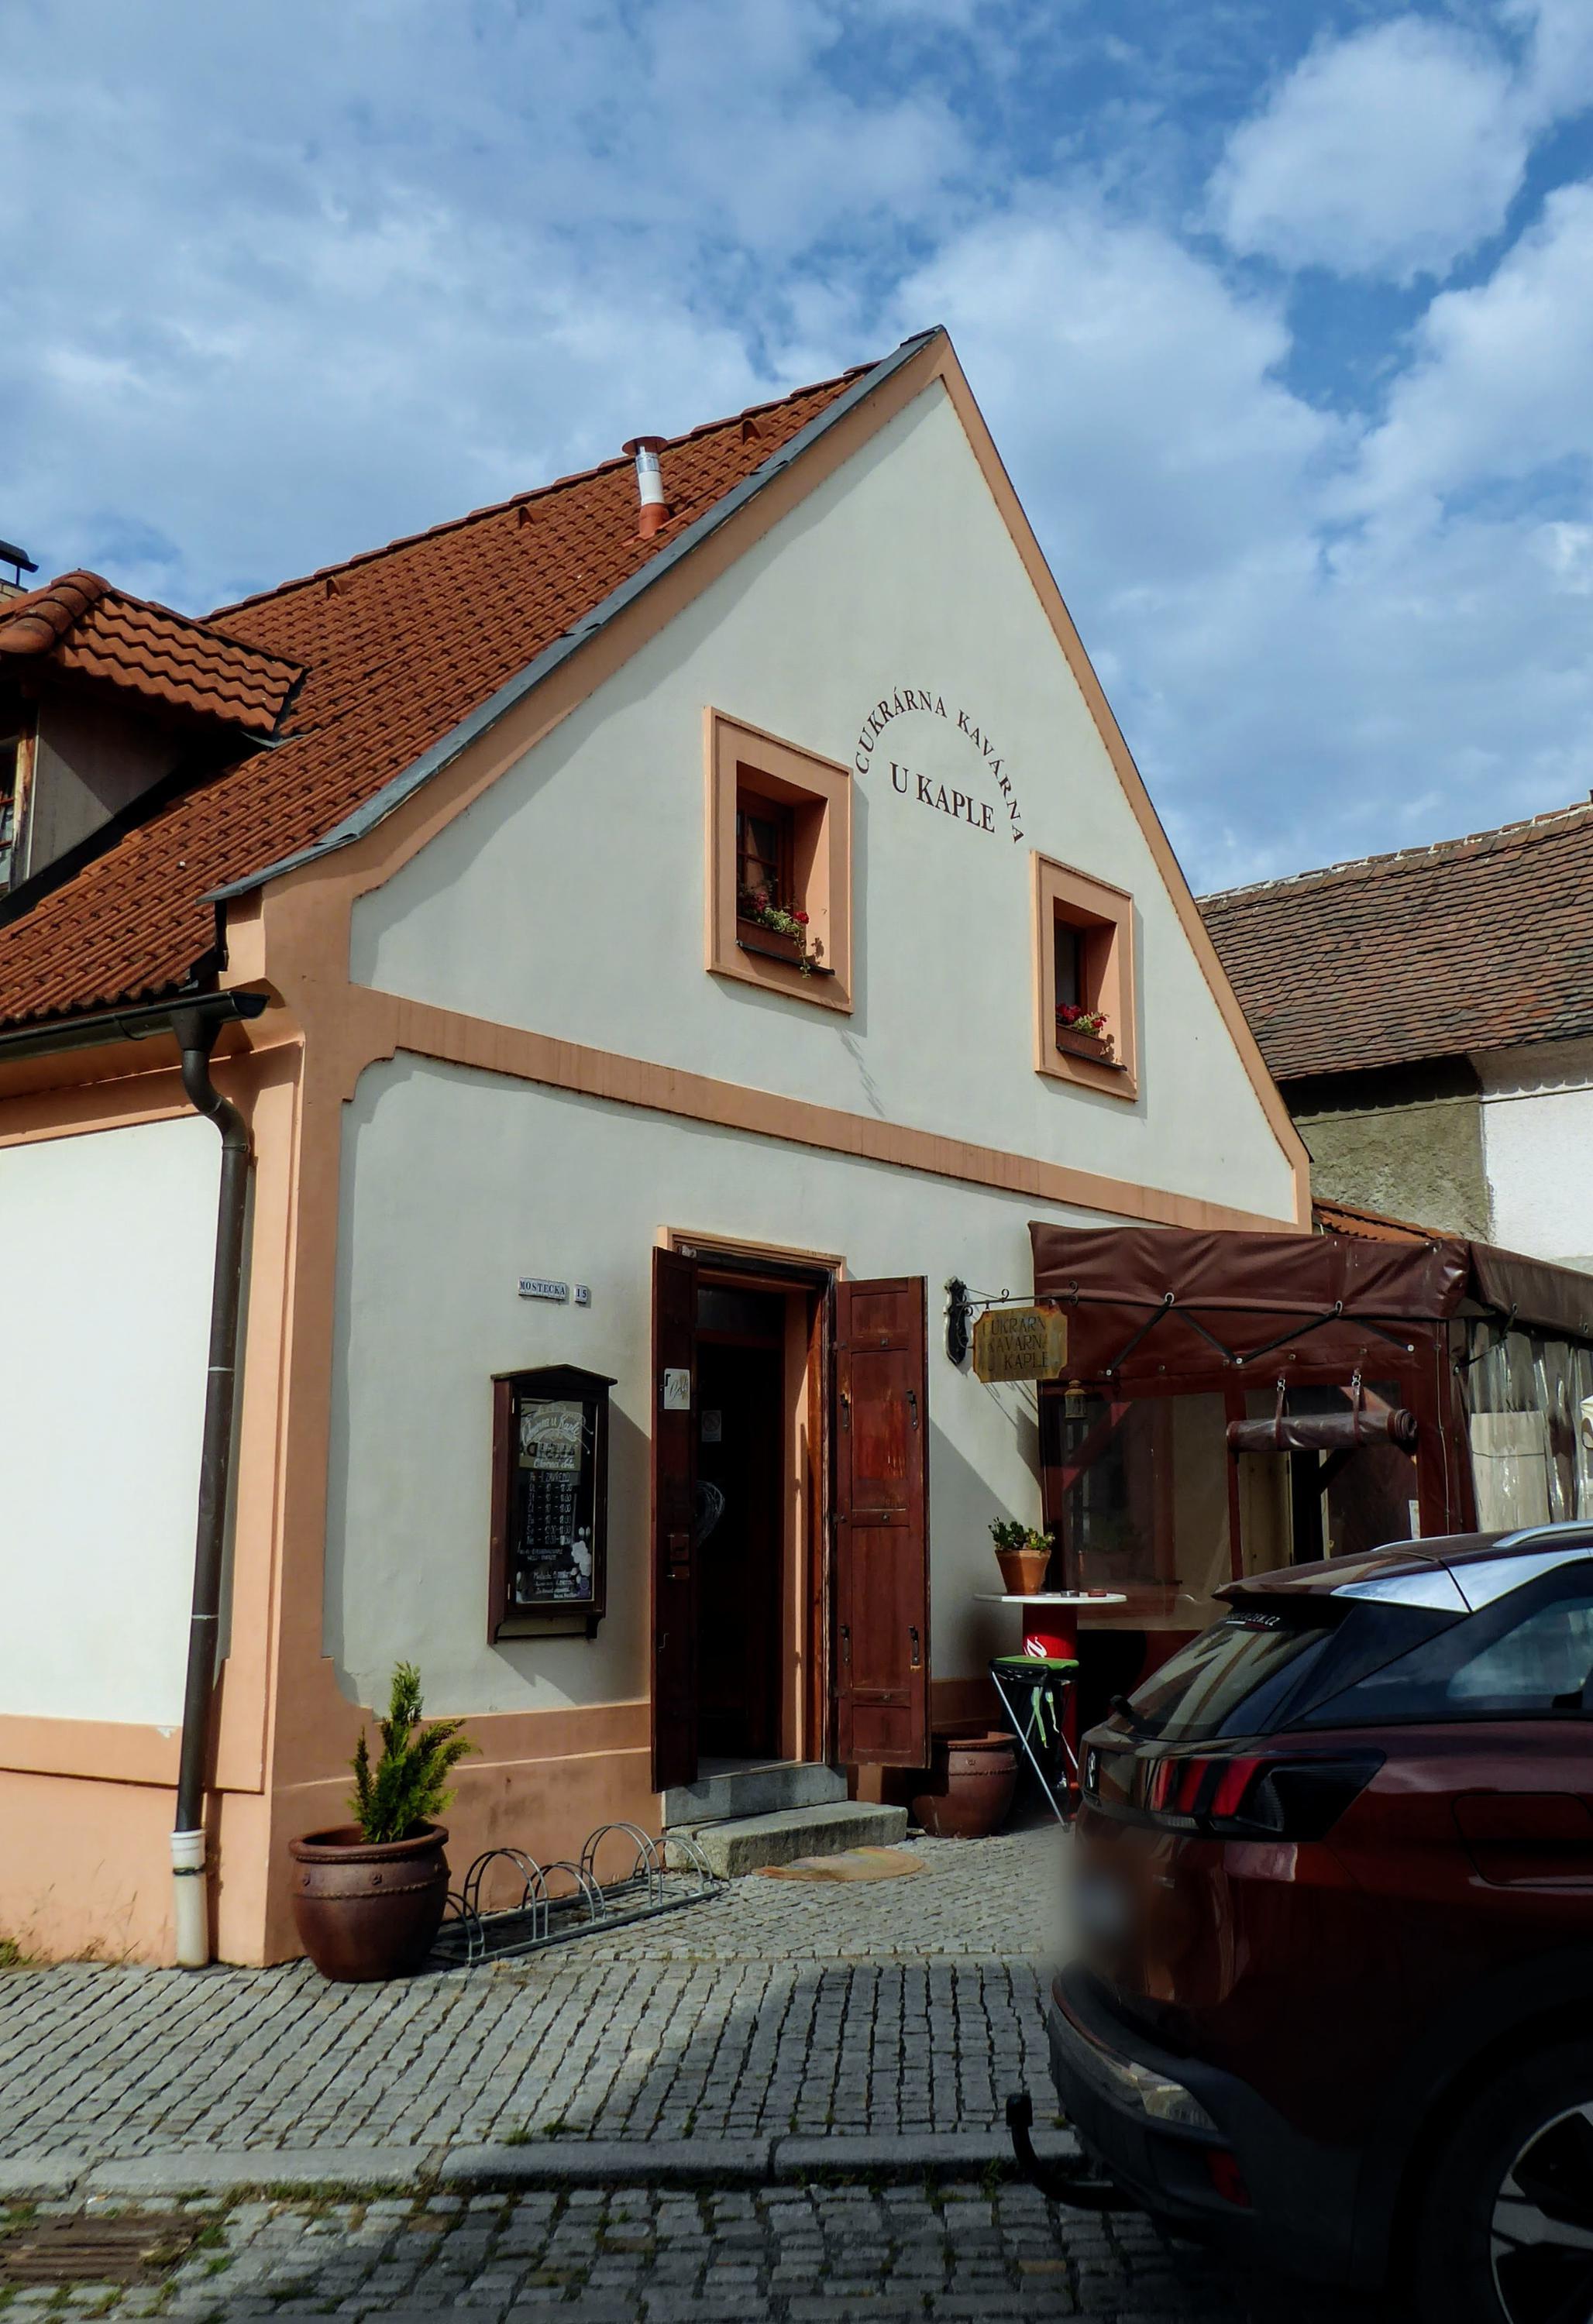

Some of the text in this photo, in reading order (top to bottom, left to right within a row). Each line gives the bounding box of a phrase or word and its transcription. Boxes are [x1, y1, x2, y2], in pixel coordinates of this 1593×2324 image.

[855, 686, 1024, 843] CUKRÁRNA KAVÁRNA
[889, 761, 995, 833] U KAPLE
